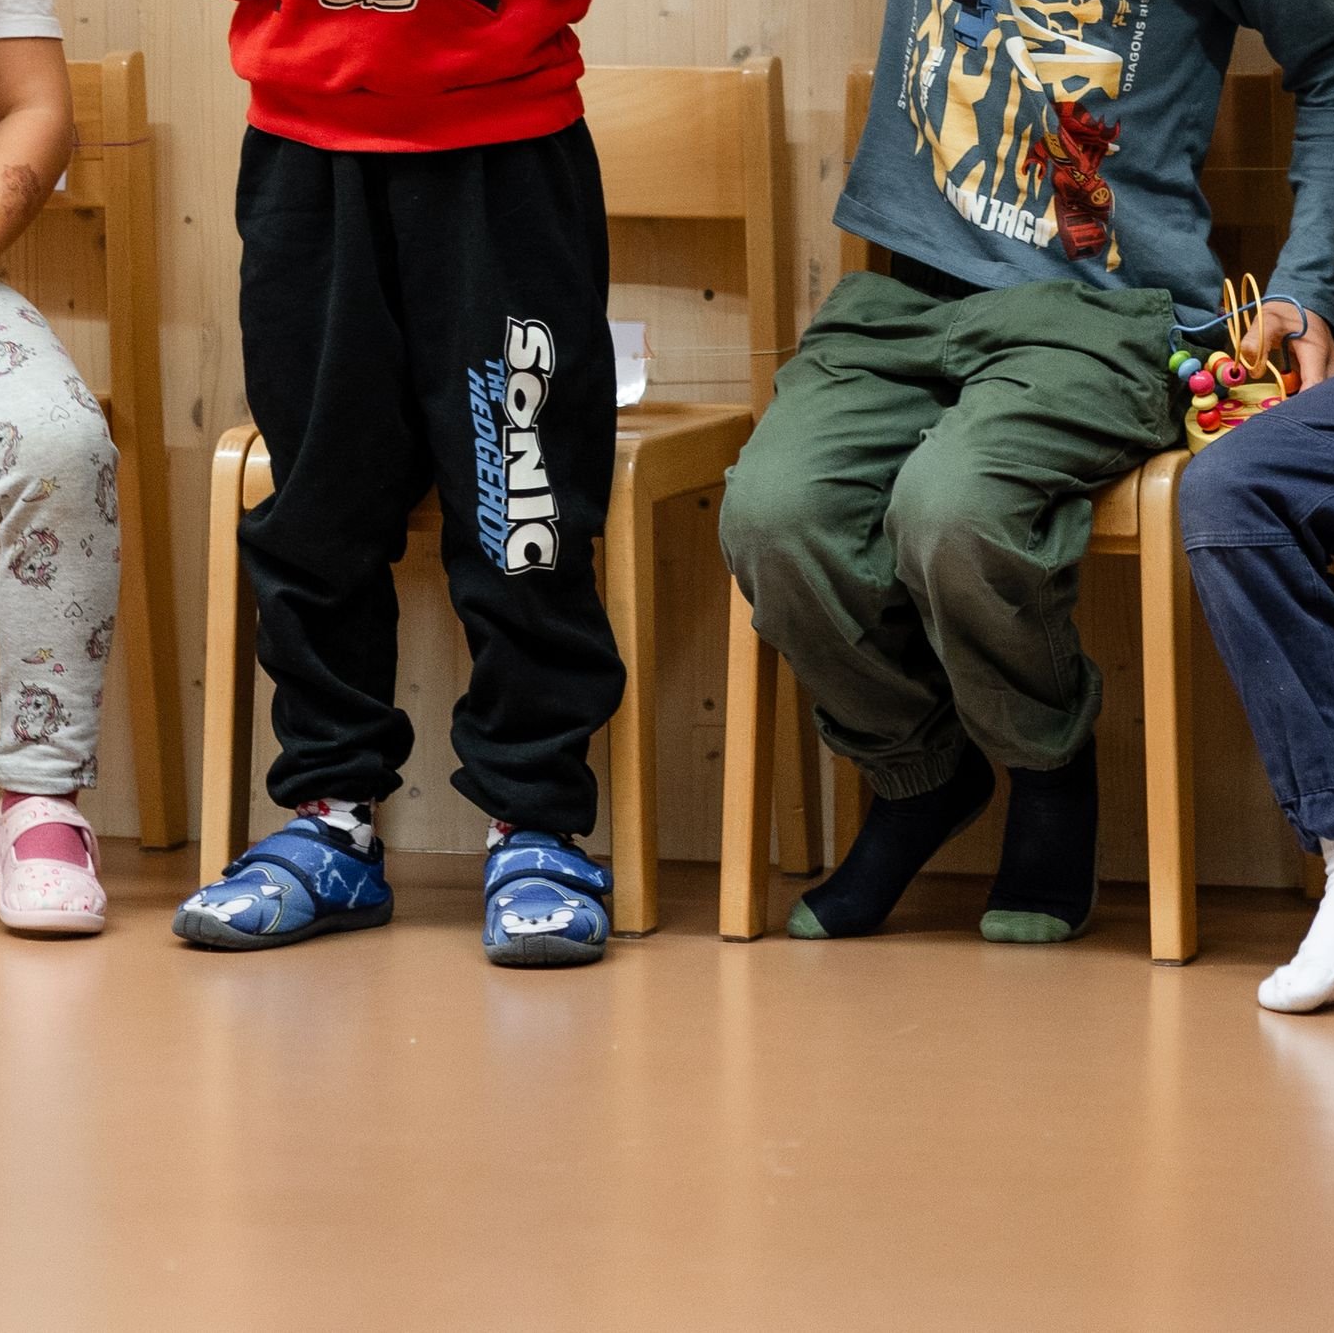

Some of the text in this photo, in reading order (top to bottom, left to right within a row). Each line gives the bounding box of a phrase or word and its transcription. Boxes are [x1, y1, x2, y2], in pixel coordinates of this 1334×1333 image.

[1123, 21, 1147, 92] DRAGONS
[467, 358, 510, 570] THE HEDGEHOG
[504, 317, 559, 575] SONIC
